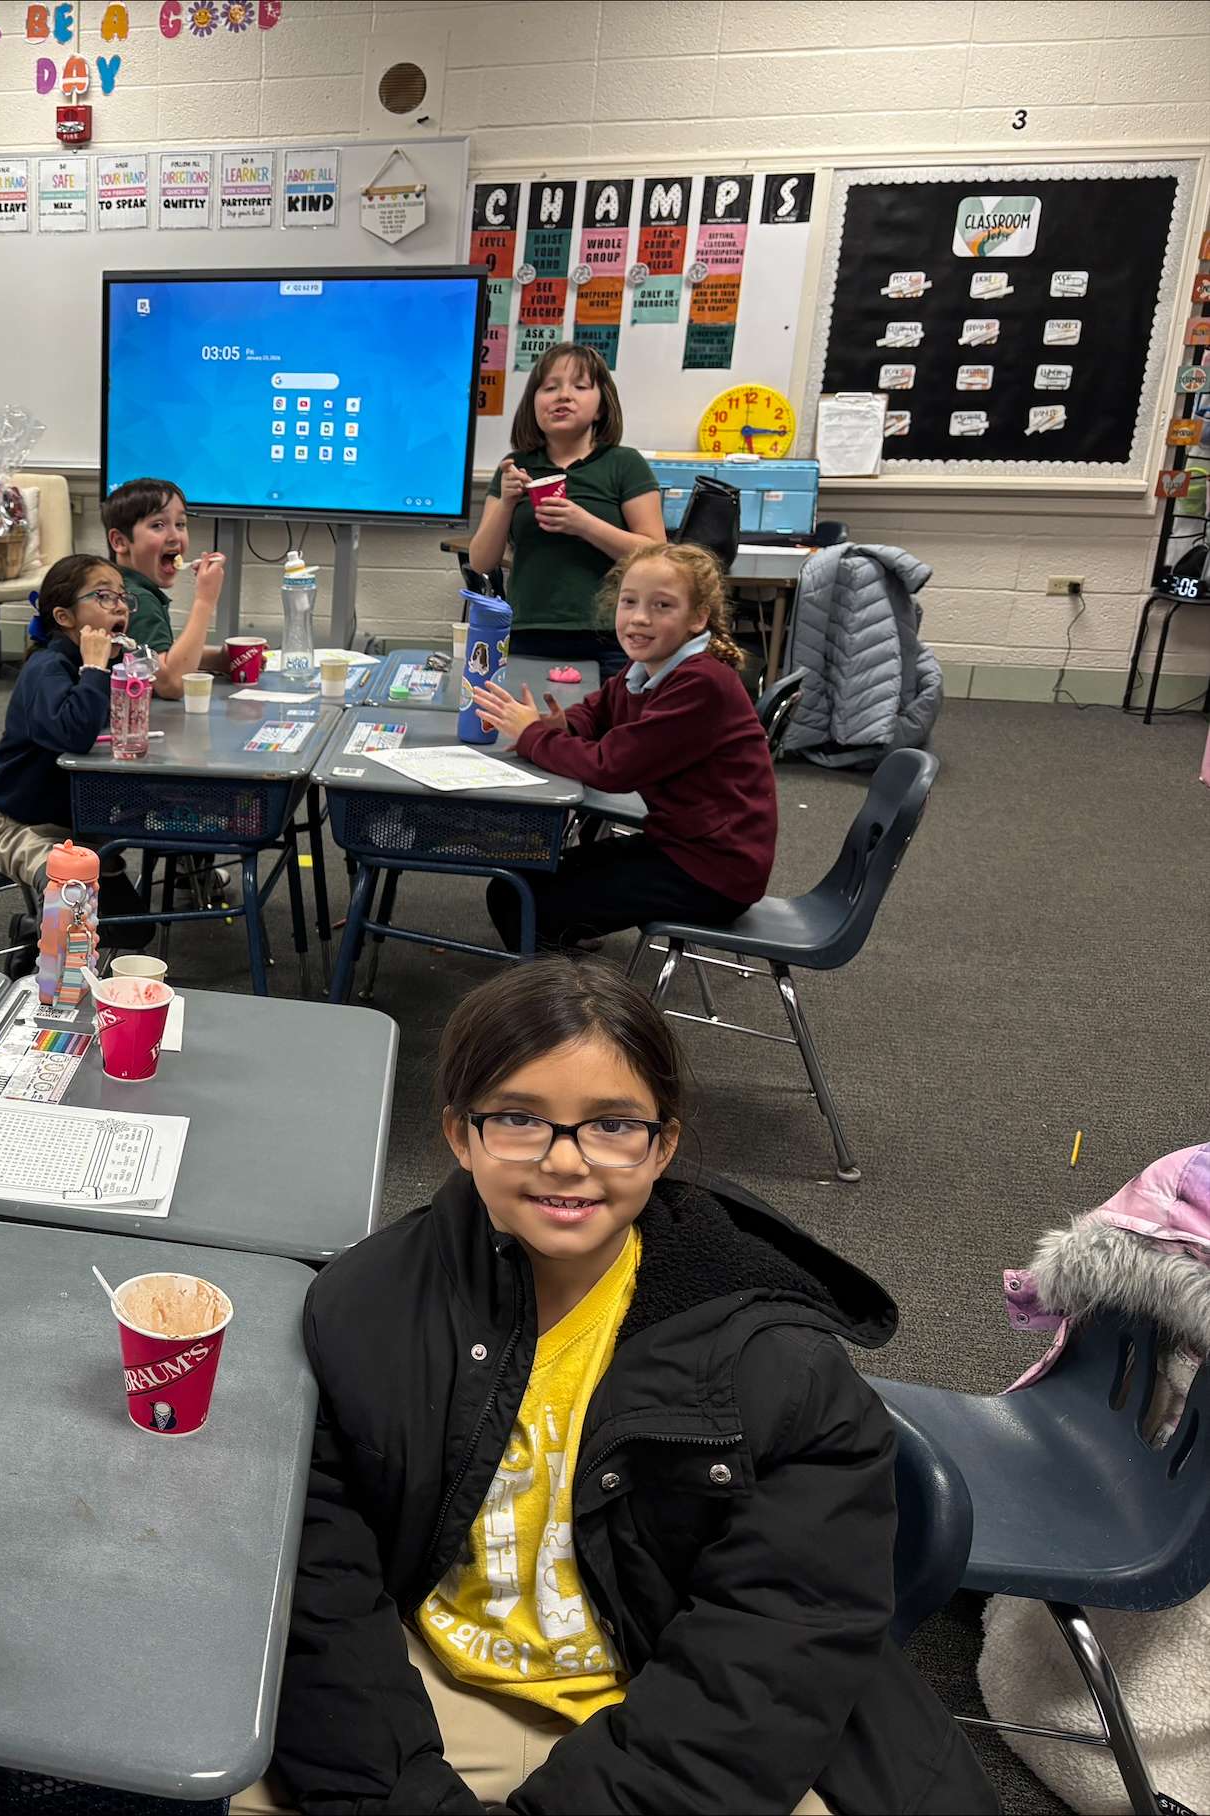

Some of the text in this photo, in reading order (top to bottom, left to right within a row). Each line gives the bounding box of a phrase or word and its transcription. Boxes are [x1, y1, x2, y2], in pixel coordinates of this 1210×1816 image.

[24, 2, 75, 44] BE
[100, 0, 130, 43] A
[35, 52, 122, 96] DAY
[1011, 109, 1028, 130] 3
[101, 171, 146, 186] YOUR HAND
[162, 170, 209, 185] DIRECTIONS
[225, 166, 270, 183] LEARNER
[287, 167, 334, 182] ABOVE ALL
[4, 176, 27, 189] HAND
[52, 174, 76, 189] SAFE
[53, 202, 73, 210] WALK
[98, 199, 147, 210] TO SPEAK
[163, 198, 206, 209] QUIETLY
[287, 194, 334, 212] KIND
[964, 212, 1031, 230] CLASSROOM
[534, 234, 563, 245] RAISE
[653, 229, 673, 239] TAKE
[479, 237, 507, 248] LEVEL
[586, 238, 623, 249] WHOLE
[644, 239, 681, 249] CARE OF
[534, 247, 561, 257] YOUR
[585, 251, 621, 263] GROUP
[649, 250, 673, 259] YOUR
[536, 282, 553, 293] SEE
[531, 294, 557, 305] YOUR
[640, 289, 675, 299] ONLY IN
[589, 300, 609, 308] WORK
[633, 300, 679, 308] EMERGENCY
[521, 307, 565, 318] TEACHER
[525, 328, 555, 339] ASK 3
[201, 345, 241, 361] 03:05
[728, 398, 739, 409] 11
[743, 392, 758, 404] 12
[764, 396, 771, 408] 1
[713, 411, 728, 423] 10
[774, 408, 783, 420] 2
[708, 426, 717, 437] 9
[712, 441, 721, 452] 8
[770, 441, 778, 453] 4
[123, 1342, 210, 1392] BRAUM'S
